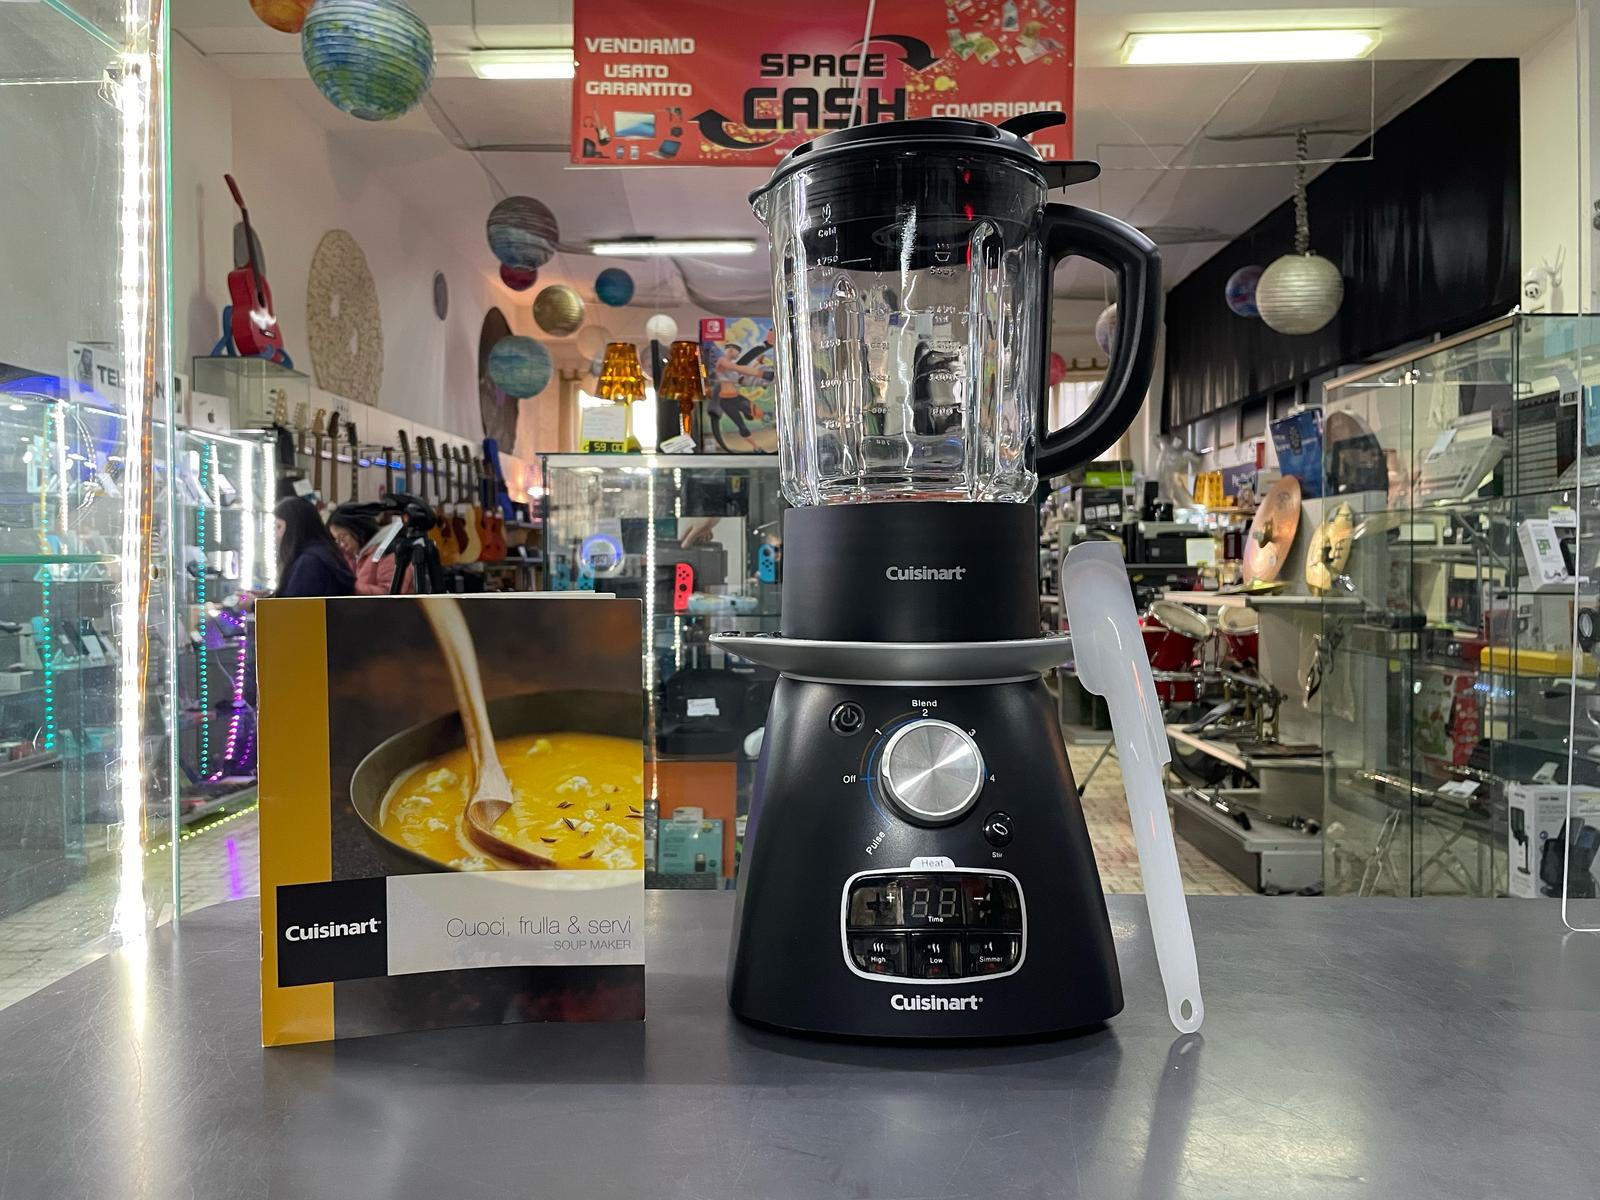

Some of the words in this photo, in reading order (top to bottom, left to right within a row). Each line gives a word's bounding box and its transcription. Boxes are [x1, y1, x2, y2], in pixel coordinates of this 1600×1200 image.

[584, 37, 696, 55] VENDIAMO
[603, 63, 670, 79] USATO
[760, 53, 886, 77] SPACE
[585, 80, 693, 97] GARANTITO
[744, 87, 907, 130] CASH
[885, 565, 964, 581] Cuisinart
[911, 699, 938, 707] Blend
[922, 708, 929, 717] 2
[874, 728, 883, 736] 1
[968, 728, 977, 738] 3
[842, 774, 857, 784] Off
[989, 774, 996, 783] 4
[865, 831, 886, 856] Pulse
[921, 859, 945, 868] Heat
[927, 915, 944, 923] Time
[285, 917, 383, 942] Cuisinart
[446, 916, 511, 938] Cuoci,
[519, 915, 562, 935] frulla
[567, 915, 583, 935] &
[587, 915, 632, 935] servi
[553, 939, 588, 951] SOUP
[590, 939, 632, 951] MAKER
[979, 955, 1004, 963] Simmer
[890, 994, 984, 1011] Cuisinart
